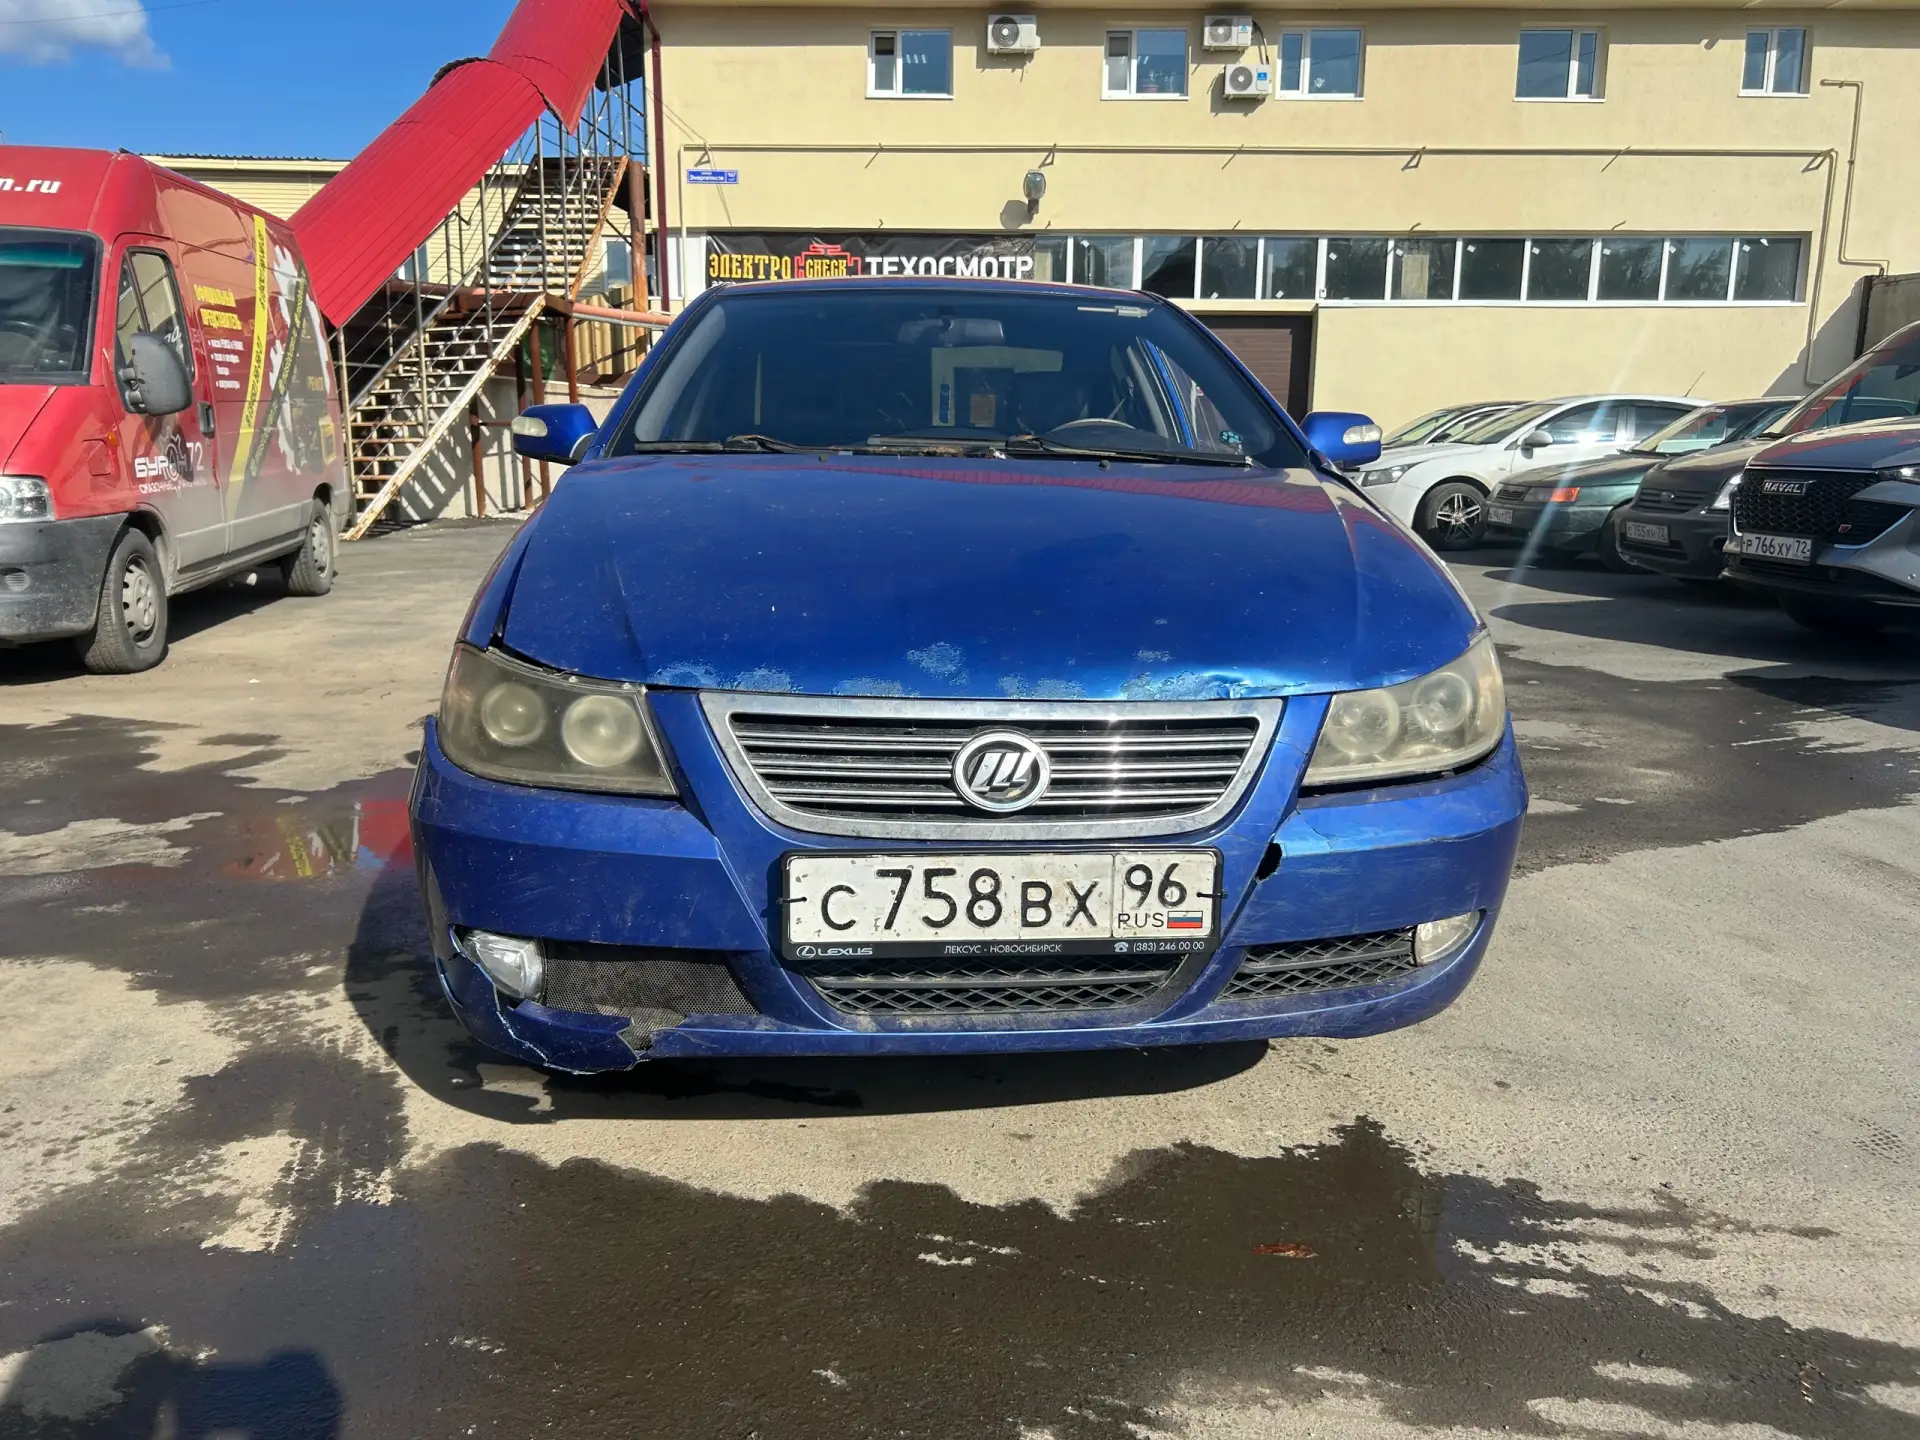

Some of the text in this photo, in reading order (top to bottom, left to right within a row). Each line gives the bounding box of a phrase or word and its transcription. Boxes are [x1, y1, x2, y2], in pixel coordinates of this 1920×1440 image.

[709, 253, 791, 281] ЭЛЕКТРО
[865, 256, 1034, 279] ТЕХОСМОТР
[1763, 482, 1801, 493] HAVAL
[1124, 862, 1188, 908] 96
[1117, 912, 1165, 929] RUS
[817, 947, 873, 956] LEXUS
[944, 945, 981, 954] ЛЕКСУС
[989, 944, 1062, 954] НОВОСИБИРСК
[1133, 941, 1204, 952] (383) 246 00 00
